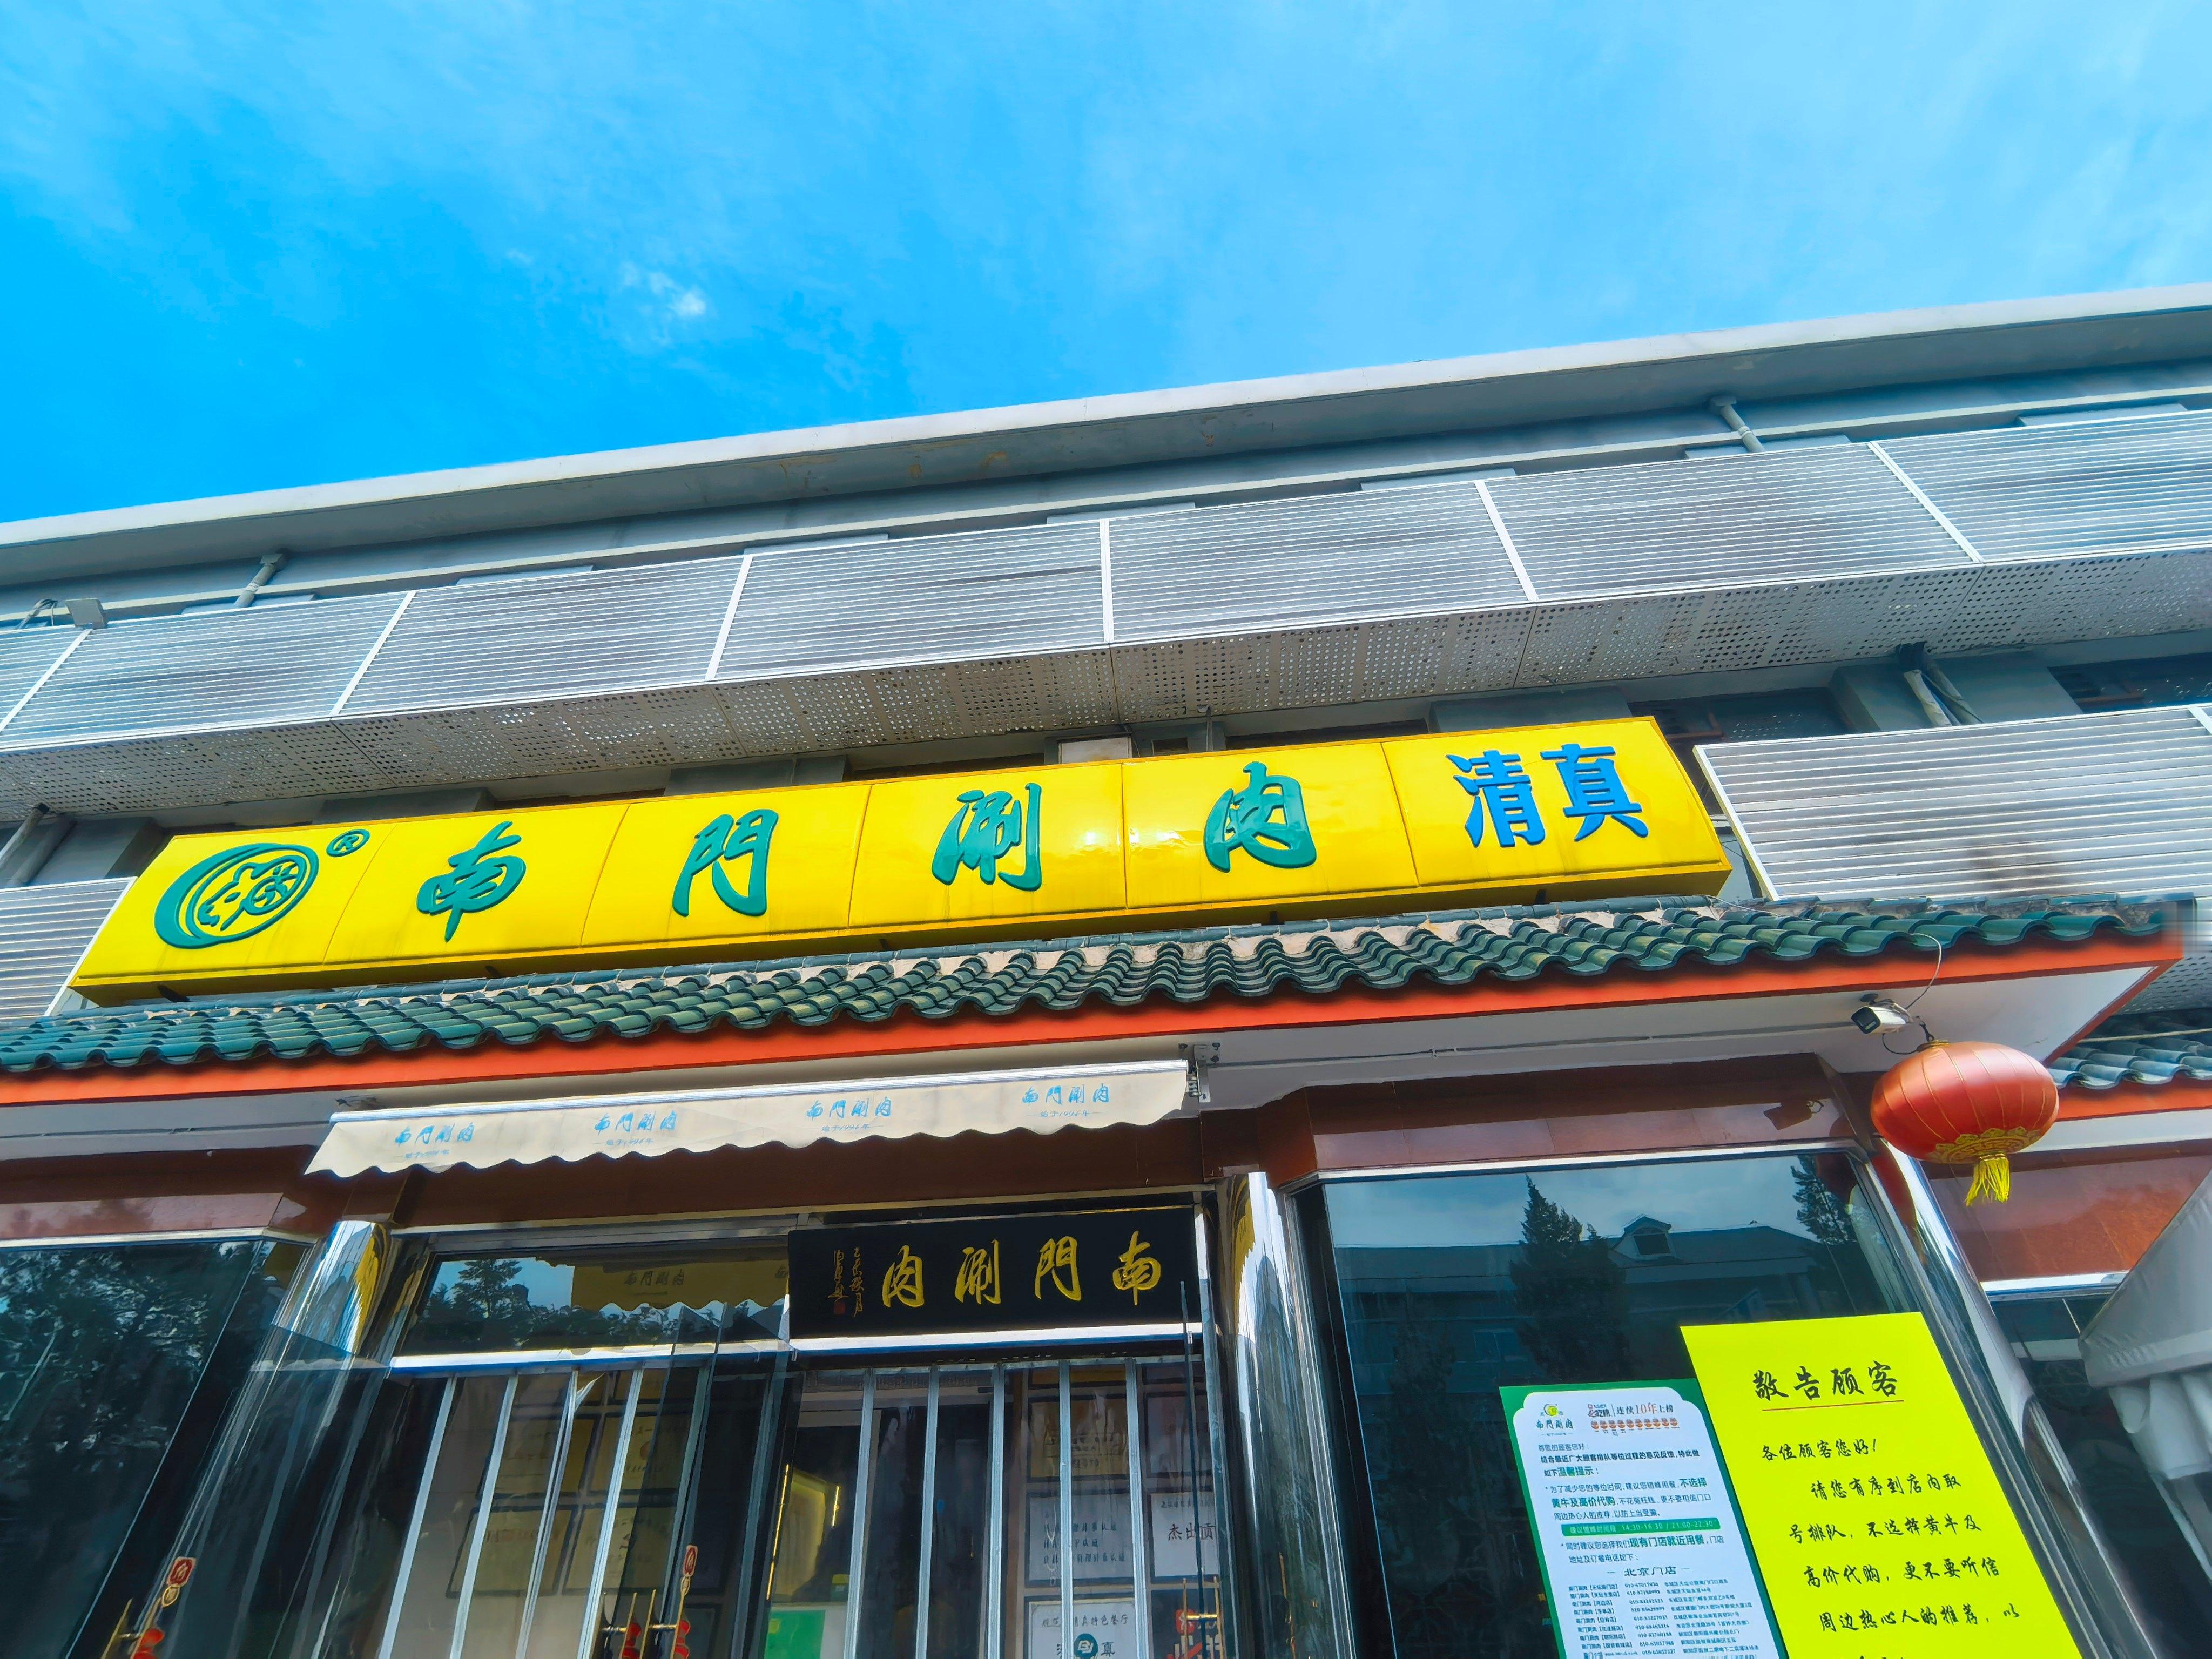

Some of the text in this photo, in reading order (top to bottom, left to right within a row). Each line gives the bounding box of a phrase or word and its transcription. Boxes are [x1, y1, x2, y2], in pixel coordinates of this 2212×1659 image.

[1446, 744, 1648, 848] 清真
[1752, 1360, 1898, 1401] 敬告顾客
[1762, 1438, 1876, 1460] 各位顾客您好！
[1811, 1474, 1961, 1500] 请您有序到店内取
[1624, 1566, 1677, 1576] 北京门店
[1803, 1557, 1999, 1588] 高价代购，更不要听信
